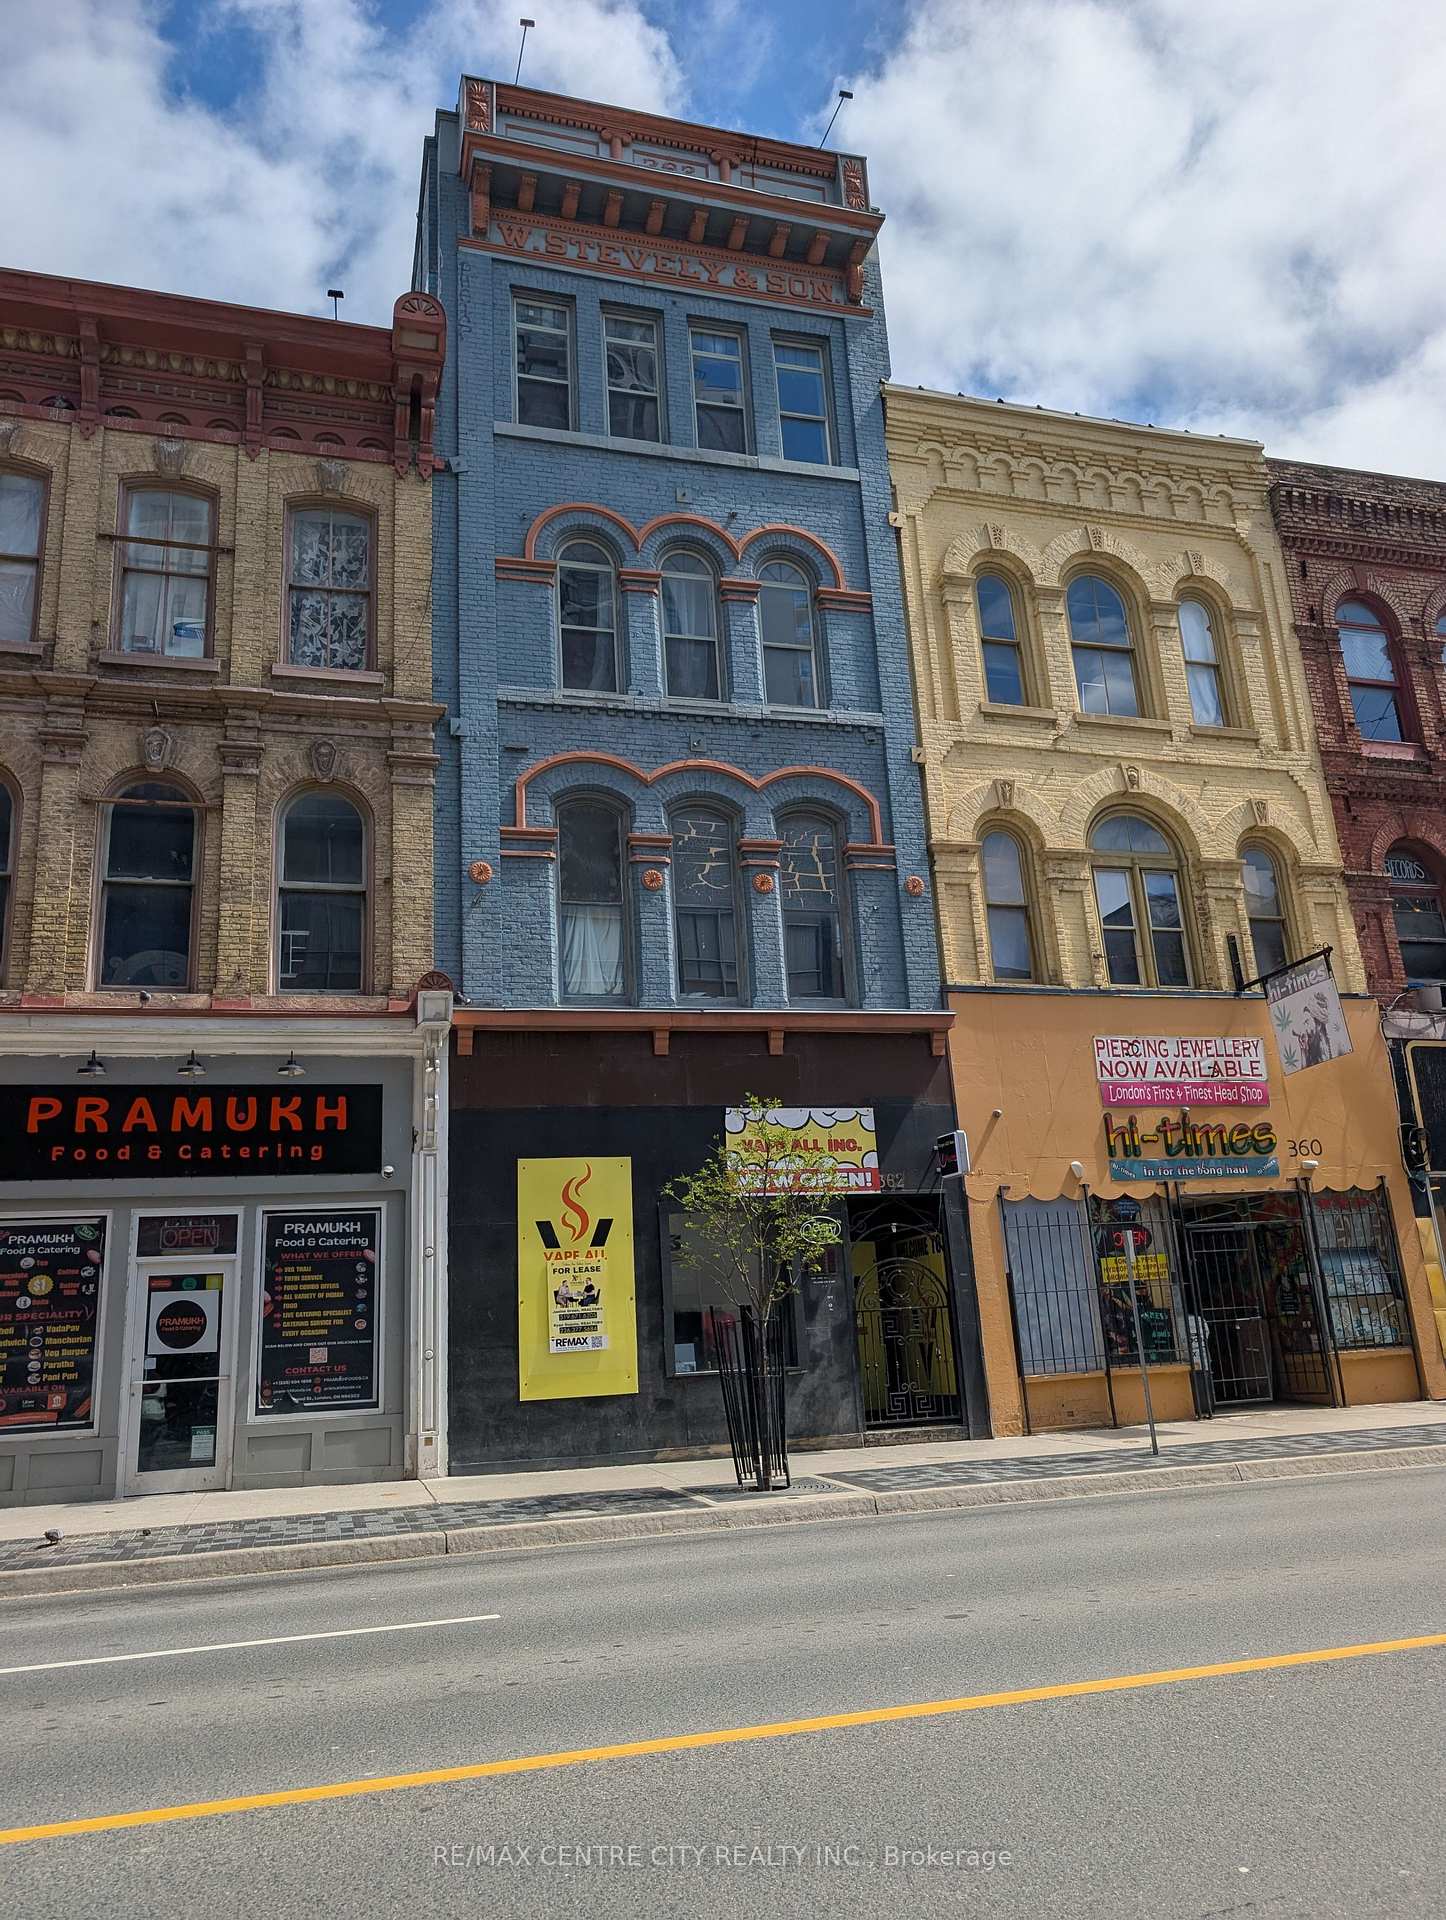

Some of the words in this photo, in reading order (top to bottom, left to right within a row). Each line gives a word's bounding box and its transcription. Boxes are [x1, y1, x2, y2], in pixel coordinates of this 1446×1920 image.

[544, 232, 729, 285] STEVELY
[733, 267, 759, 291] &
[1268, 967, 1327, 1002] hi-times
[1095, 1039, 1169, 1058] PIERCING
[1173, 1039, 1260, 1058] JEWELLERY
[1099, 1060, 1149, 1078] NOW
[1153, 1060, 1263, 1078] AVAILABLE
[1109, 1085, 1151, 1102] London's
[1152, 1085, 1175, 1101] First
[1176, 1088, 1183, 1097] &
[1183, 1085, 1213, 1101] Finest
[1214, 1085, 1238, 1100] Head
[1239, 1085, 1263, 1103] Shop
[26, 1096, 348, 1133] PRAMUKH
[1103, 1112, 1278, 1158] hi-times
[792, 1139, 823, 1151] ALL
[827, 1138, 862, 1151] INC.
[1288, 1139, 1323, 1158] 360
[51, 1145, 130, 1161] Food
[148, 1145, 161, 1159] &
[178, 1143, 323, 1160] Catering
[1143, 1166, 1155, 1177] in
[1158, 1166, 1174, 1176] for
[1177, 1165, 1195, 1176] the
[1198, 1164, 1223, 1177] bong
[1226, 1165, 1249, 1175] haul
[737, 1172, 794, 1188] NOW
[800, 1172, 872, 1187] OPEN!
[284, 1221, 361, 1234] PRAMUKH
[8, 1234, 75, 1244] PRAMUKH
[164, 1229, 216, 1247] OPEN
[275, 1238, 305, 1247] Food
[307, 1238, 316, 1247] &
[319, 1236, 369, 1247] Catering
[1113, 1232, 1147, 1248] OEN
[0, 1247, 26, 1255] Food
[37, 1246, 80, 1255] Catering
[281, 1252, 311, 1260] WHAT
[313, 1251, 330, 1259] WE
[332, 1250, 363, 1258] OFFER
[552, 1267, 571, 1275] FOR
[573, 1265, 602, 1274] LEASE
[15, 1310, 81, 1320] SPECIALITY
[160, 1317, 204, 1326] PRAMUKH
[285, 1366, 331, 1375] CONTACT
[0, 1385, 48, 1395] AVAILABLE
